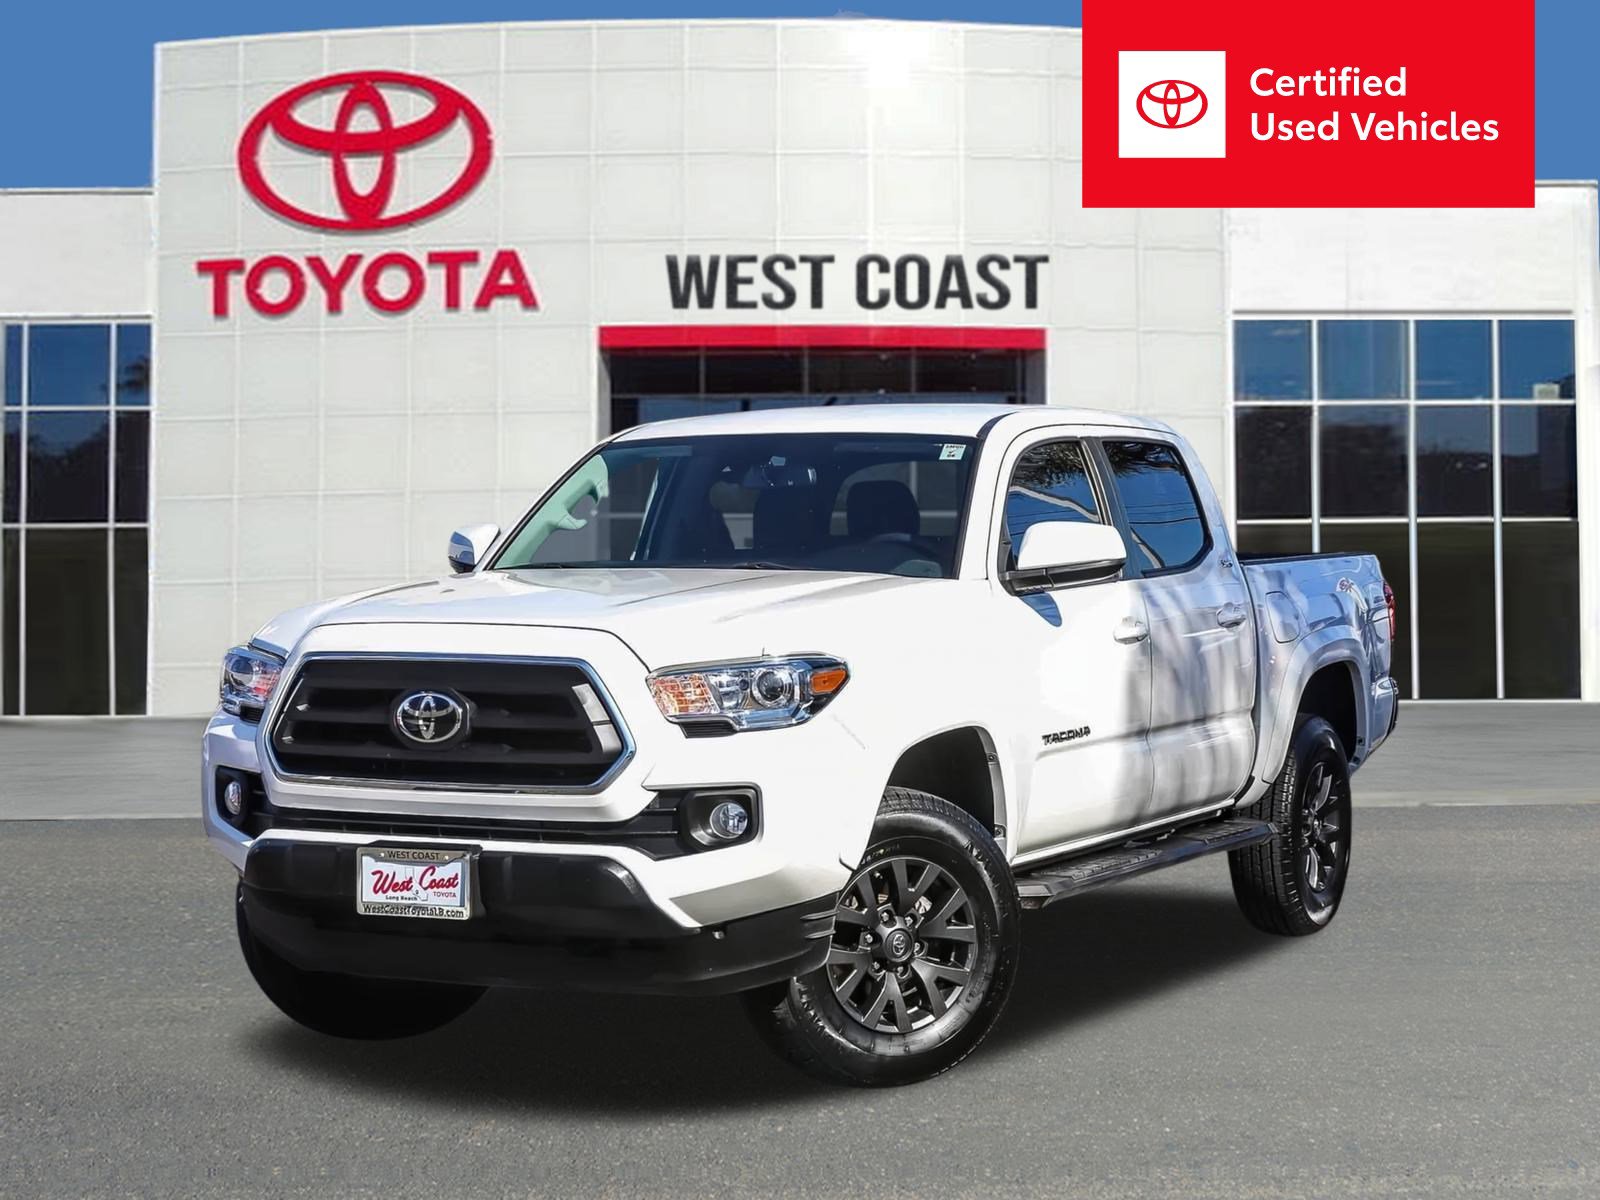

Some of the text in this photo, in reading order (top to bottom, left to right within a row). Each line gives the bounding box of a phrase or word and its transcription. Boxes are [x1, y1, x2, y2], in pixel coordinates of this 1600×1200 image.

[195, 250, 539, 318] TOYOTA
[665, 253, 1050, 310] WEST COAST
[1041, 725, 1091, 745] TACOMA
[387, 850, 440, 861] WEST COAST
[371, 865, 459, 895] West Coast
